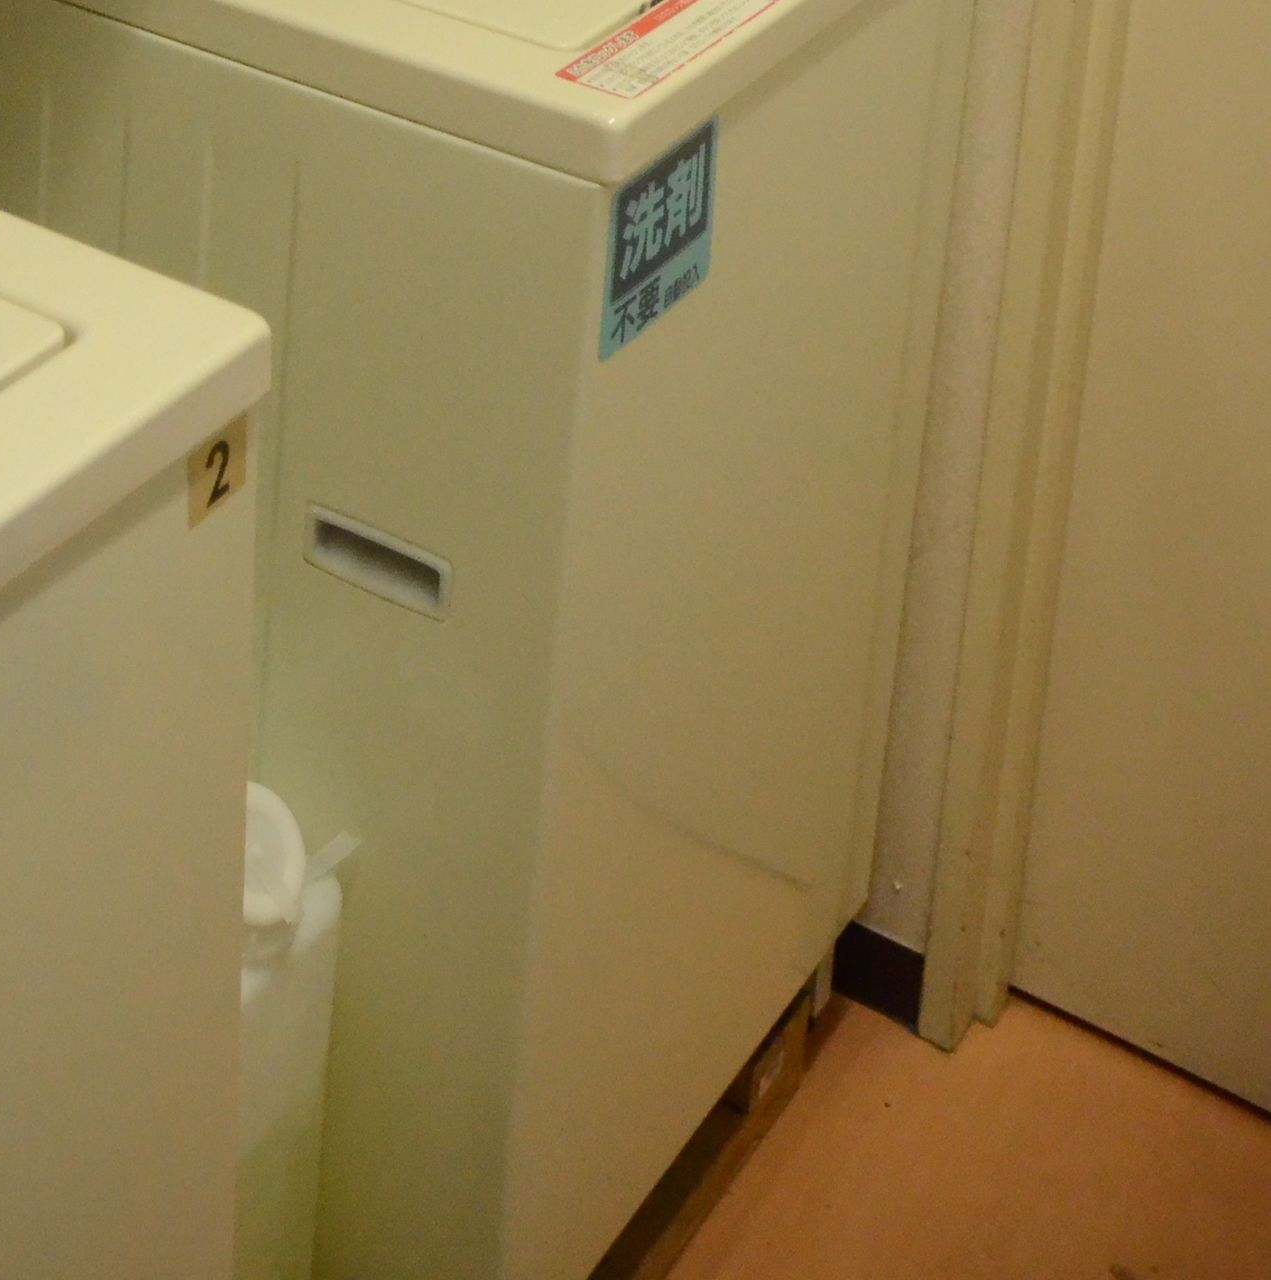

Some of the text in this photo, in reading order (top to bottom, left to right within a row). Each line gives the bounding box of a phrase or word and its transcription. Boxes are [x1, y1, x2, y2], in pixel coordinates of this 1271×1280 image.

[619, 144, 707, 282] 洗剤
[611, 274, 661, 344] 不要
[205, 439, 231, 509] 2
